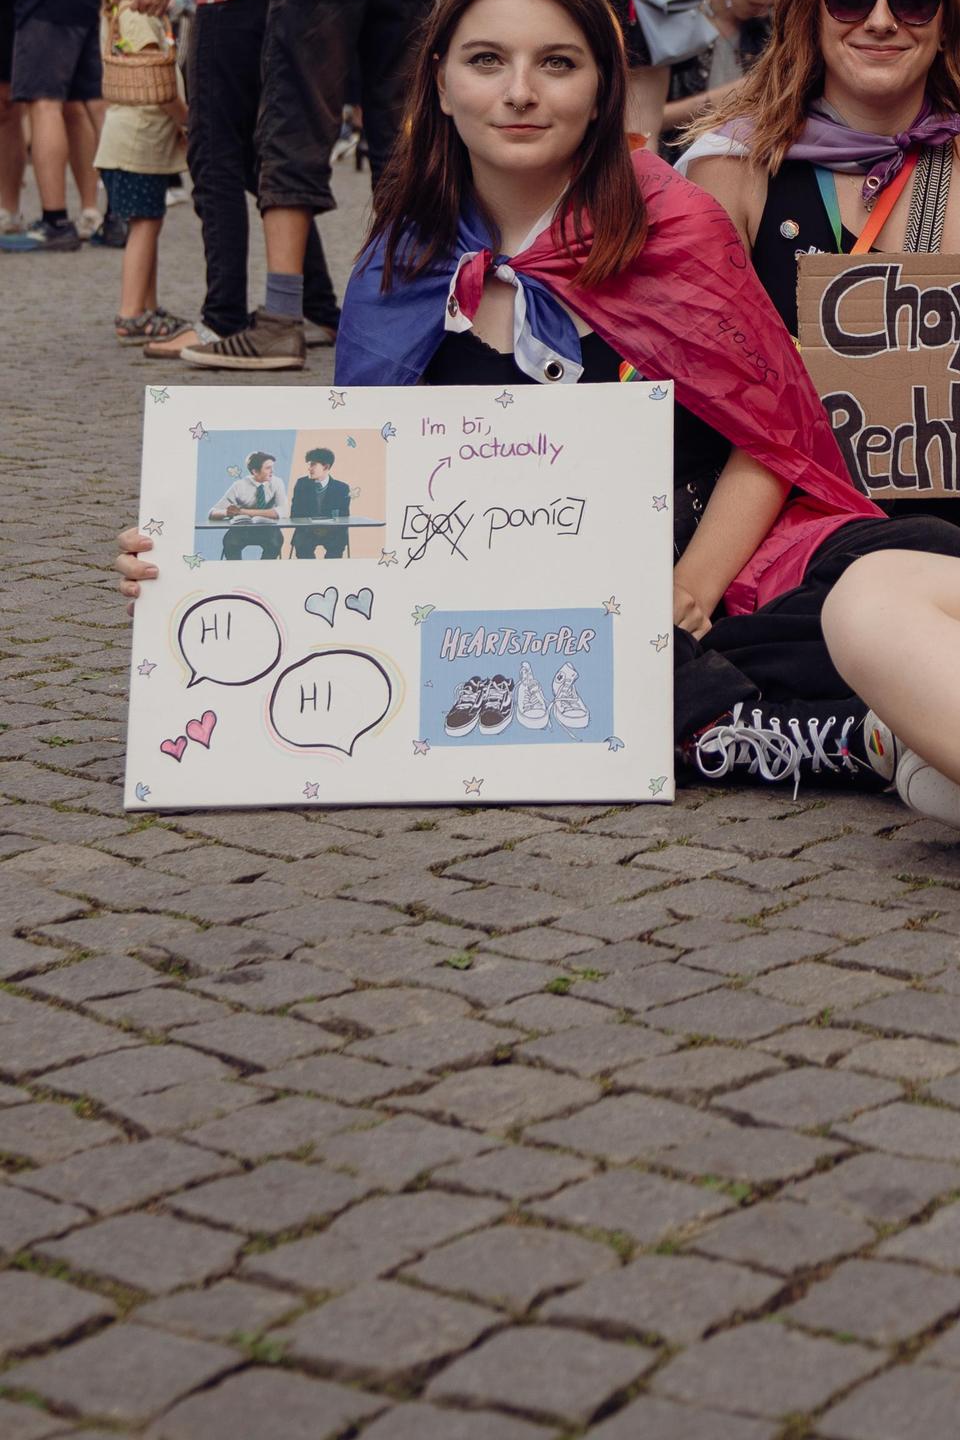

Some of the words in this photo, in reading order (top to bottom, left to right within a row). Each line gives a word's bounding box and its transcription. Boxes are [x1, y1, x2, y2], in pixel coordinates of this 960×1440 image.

[715, 314, 780, 384] Sarah
[421, 416, 446, 436] I'm
[458, 432, 565, 465] actually
[201, 611, 231, 644] HI
[439, 625, 597, 661] HEARTSTOPPER
[300, 680, 332, 714] HI
